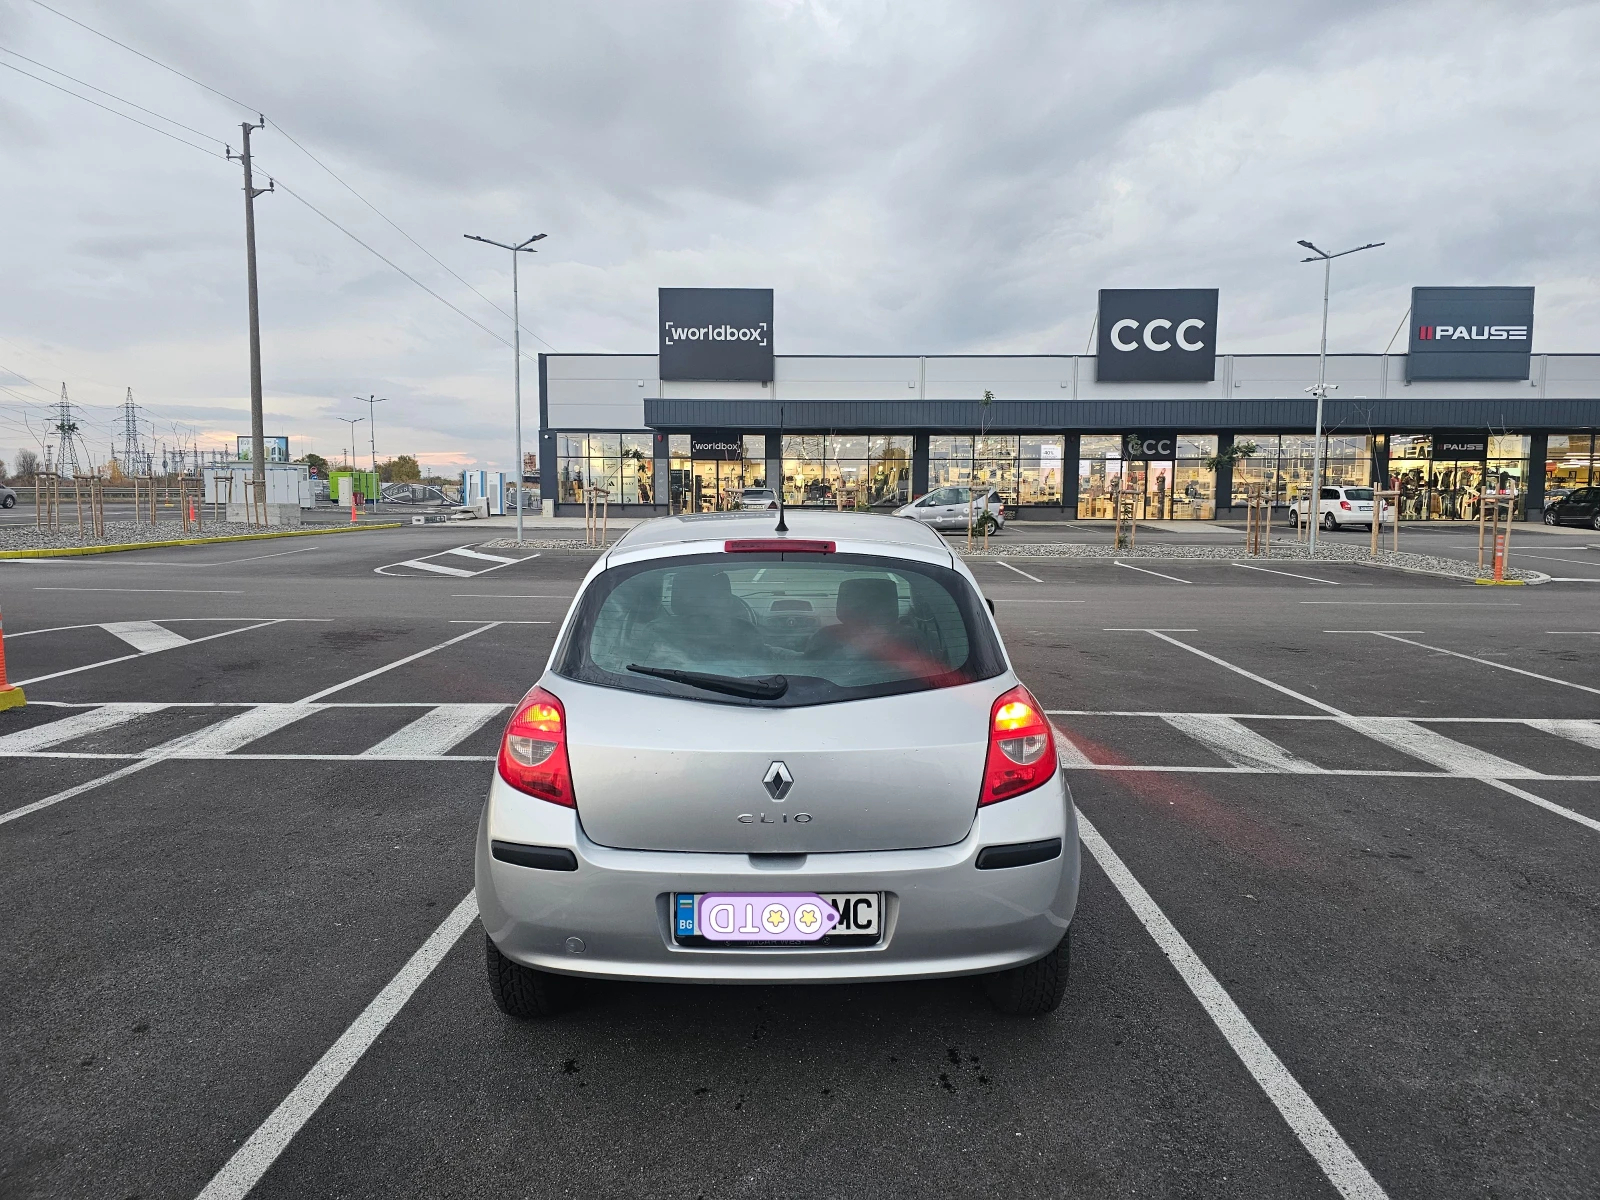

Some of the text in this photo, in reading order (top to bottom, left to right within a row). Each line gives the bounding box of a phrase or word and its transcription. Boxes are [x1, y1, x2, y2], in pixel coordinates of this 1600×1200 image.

[671, 324, 762, 342] worldbox
[1110, 318, 1206, 352] CCC
[1435, 325, 1528, 341] PAUSE
[694, 442, 739, 451] worldbox
[1443, 443, 1484, 451] PAUSE
[736, 812, 814, 824] CLIO
[679, 919, 693, 930] BG
